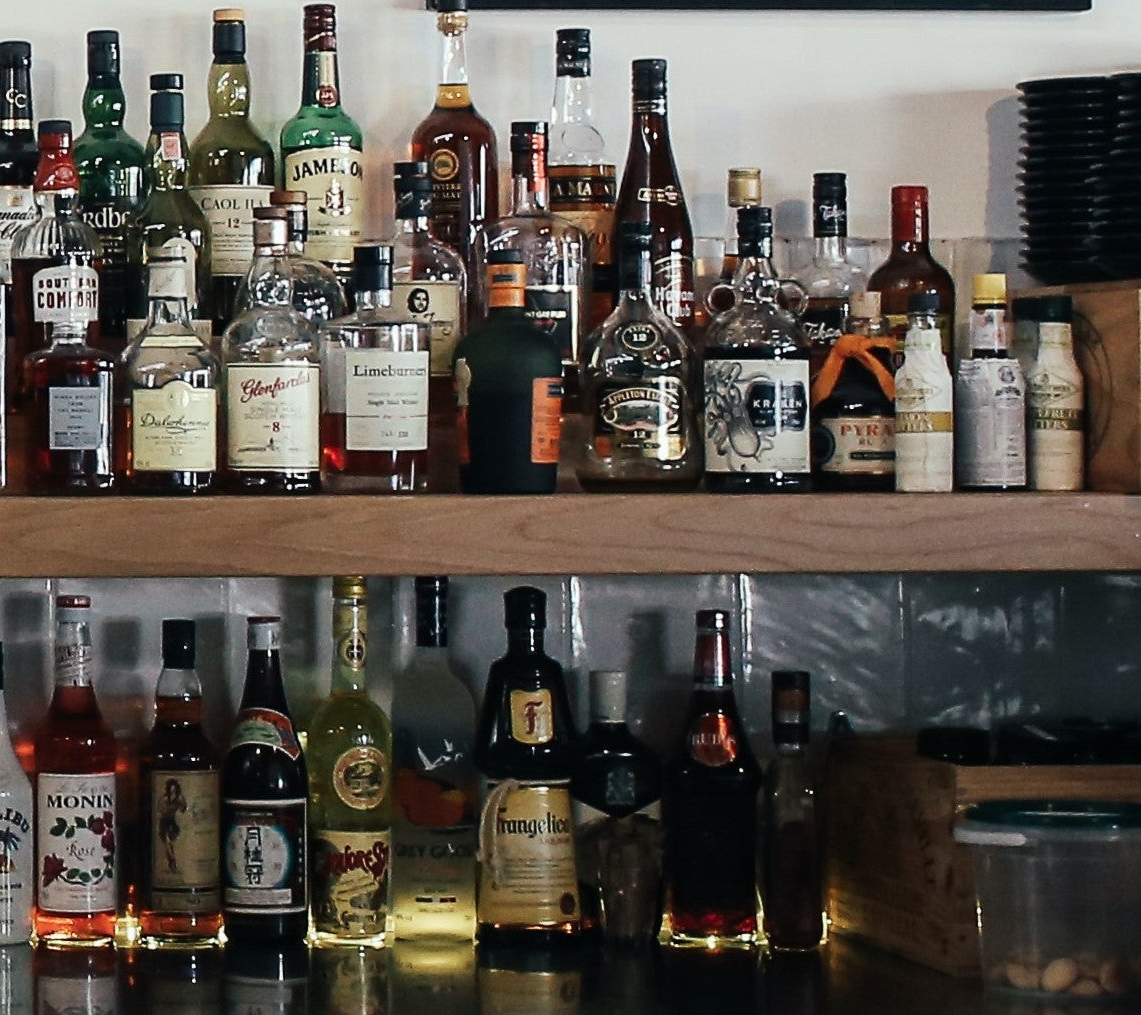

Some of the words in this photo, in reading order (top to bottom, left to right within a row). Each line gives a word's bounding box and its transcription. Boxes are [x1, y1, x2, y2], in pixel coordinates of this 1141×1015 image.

[200, 197, 241, 210] CAOL
[226, 217, 240, 229] 12
[272, 421, 281, 432] 8
[47, 794, 114, 809] MONIN
